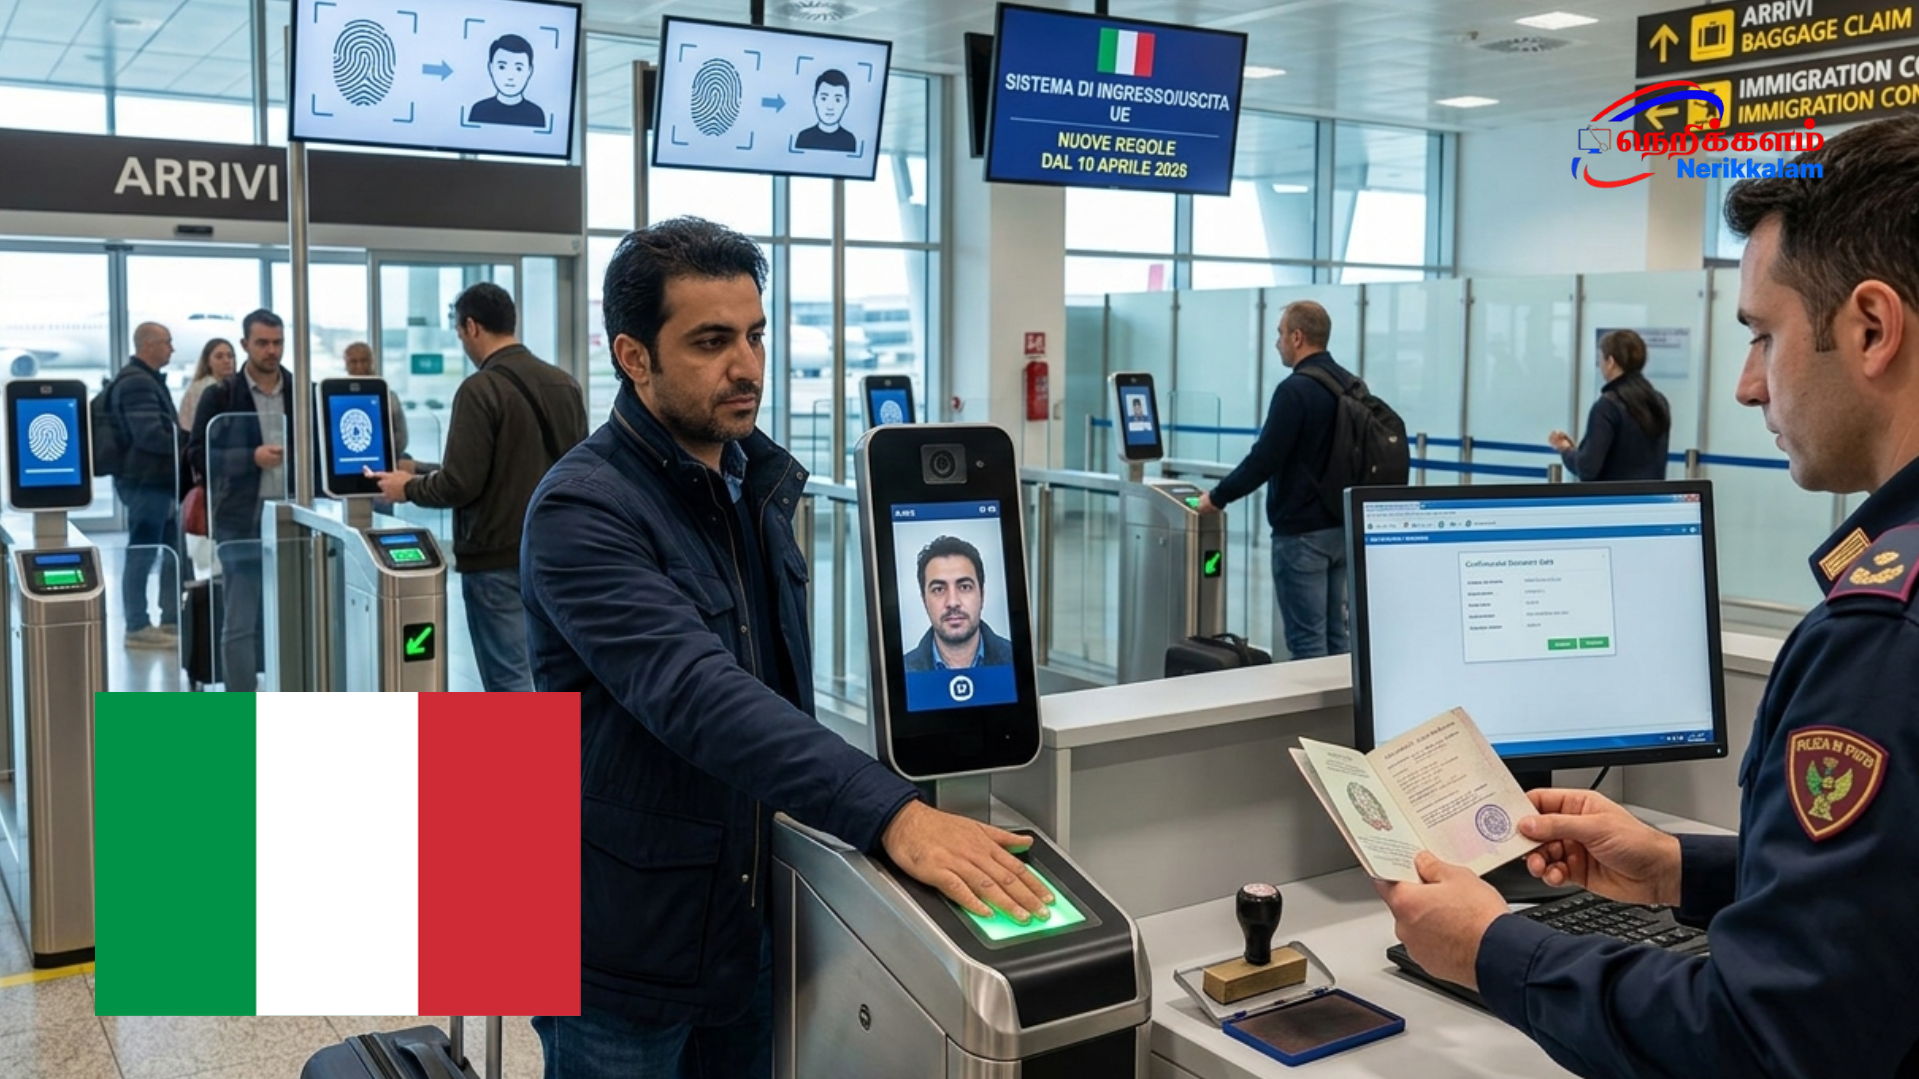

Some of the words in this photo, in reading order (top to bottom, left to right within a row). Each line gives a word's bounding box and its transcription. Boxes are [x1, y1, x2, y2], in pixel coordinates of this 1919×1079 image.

[1741, 0, 1814, 28] ARRIVI
[1741, 18, 1839, 53] BAGGAGE
[1844, 6, 1913, 37] CLAIM
[1005, 73, 1074, 96] SISTEMA
[1077, 80, 1094, 98] DI
[1097, 82, 1231, 111] INGRESSO/USCITA
[1739, 58, 1893, 99] IMMIGRATION
[1899, 55, 1919, 78] C
[1110, 105, 1132, 123] UE
[1738, 89, 1875, 124] IMMIGRATION
[1058, 131, 1112, 151] NUOVE
[1115, 136, 1177, 156] REGOLE
[114, 157, 279, 201] ARRIVI
[1041, 152, 1073, 170] DAL
[1077, 156, 1095, 172] 10
[1097, 157, 1152, 176] APRILE
